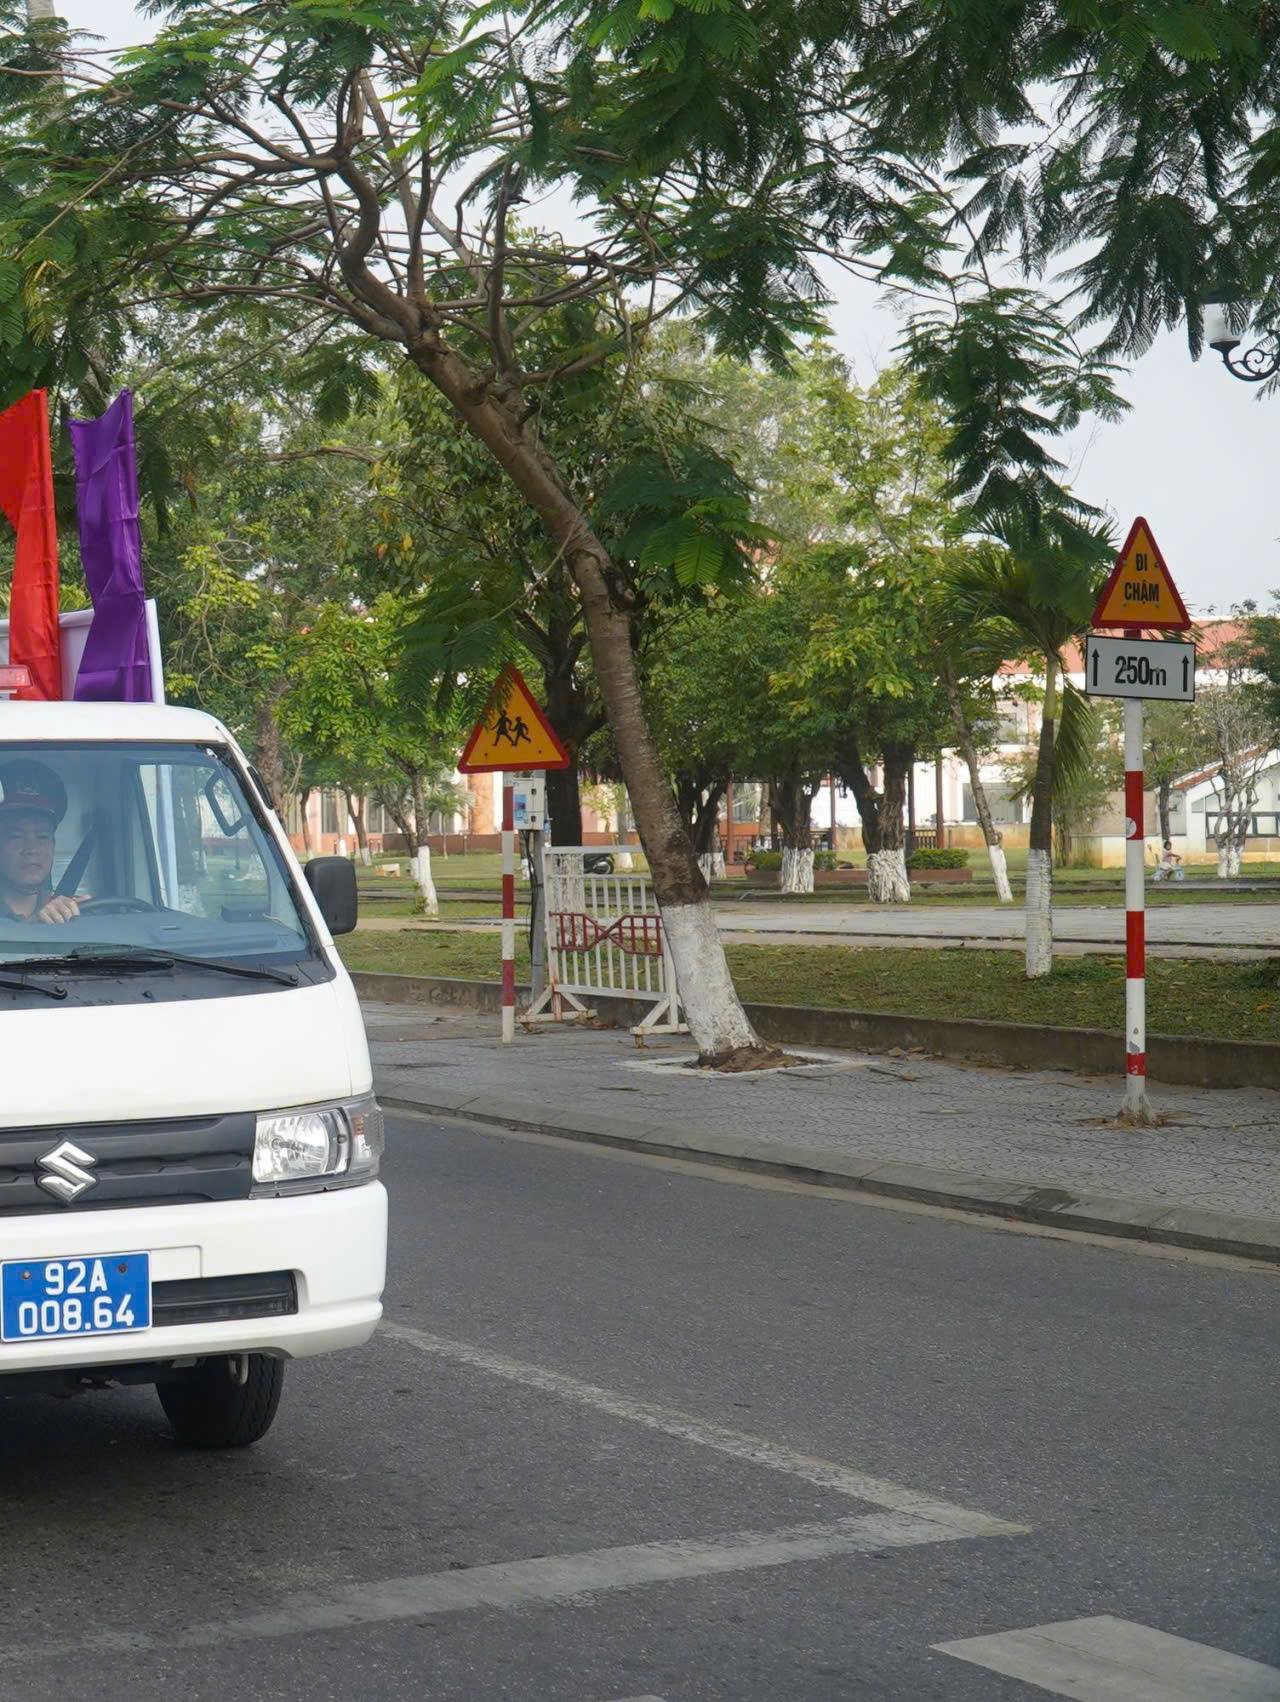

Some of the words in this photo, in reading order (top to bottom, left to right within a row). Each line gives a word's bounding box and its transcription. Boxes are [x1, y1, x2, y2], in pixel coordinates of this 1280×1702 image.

[1135, 553, 1148, 571] ĐI
[1124, 580, 1160, 605] CHẬM
[1114, 655, 1167, 686] 250m
[44, 1259, 109, 1296] 92A
[18, 1294, 135, 1335] 008.64
